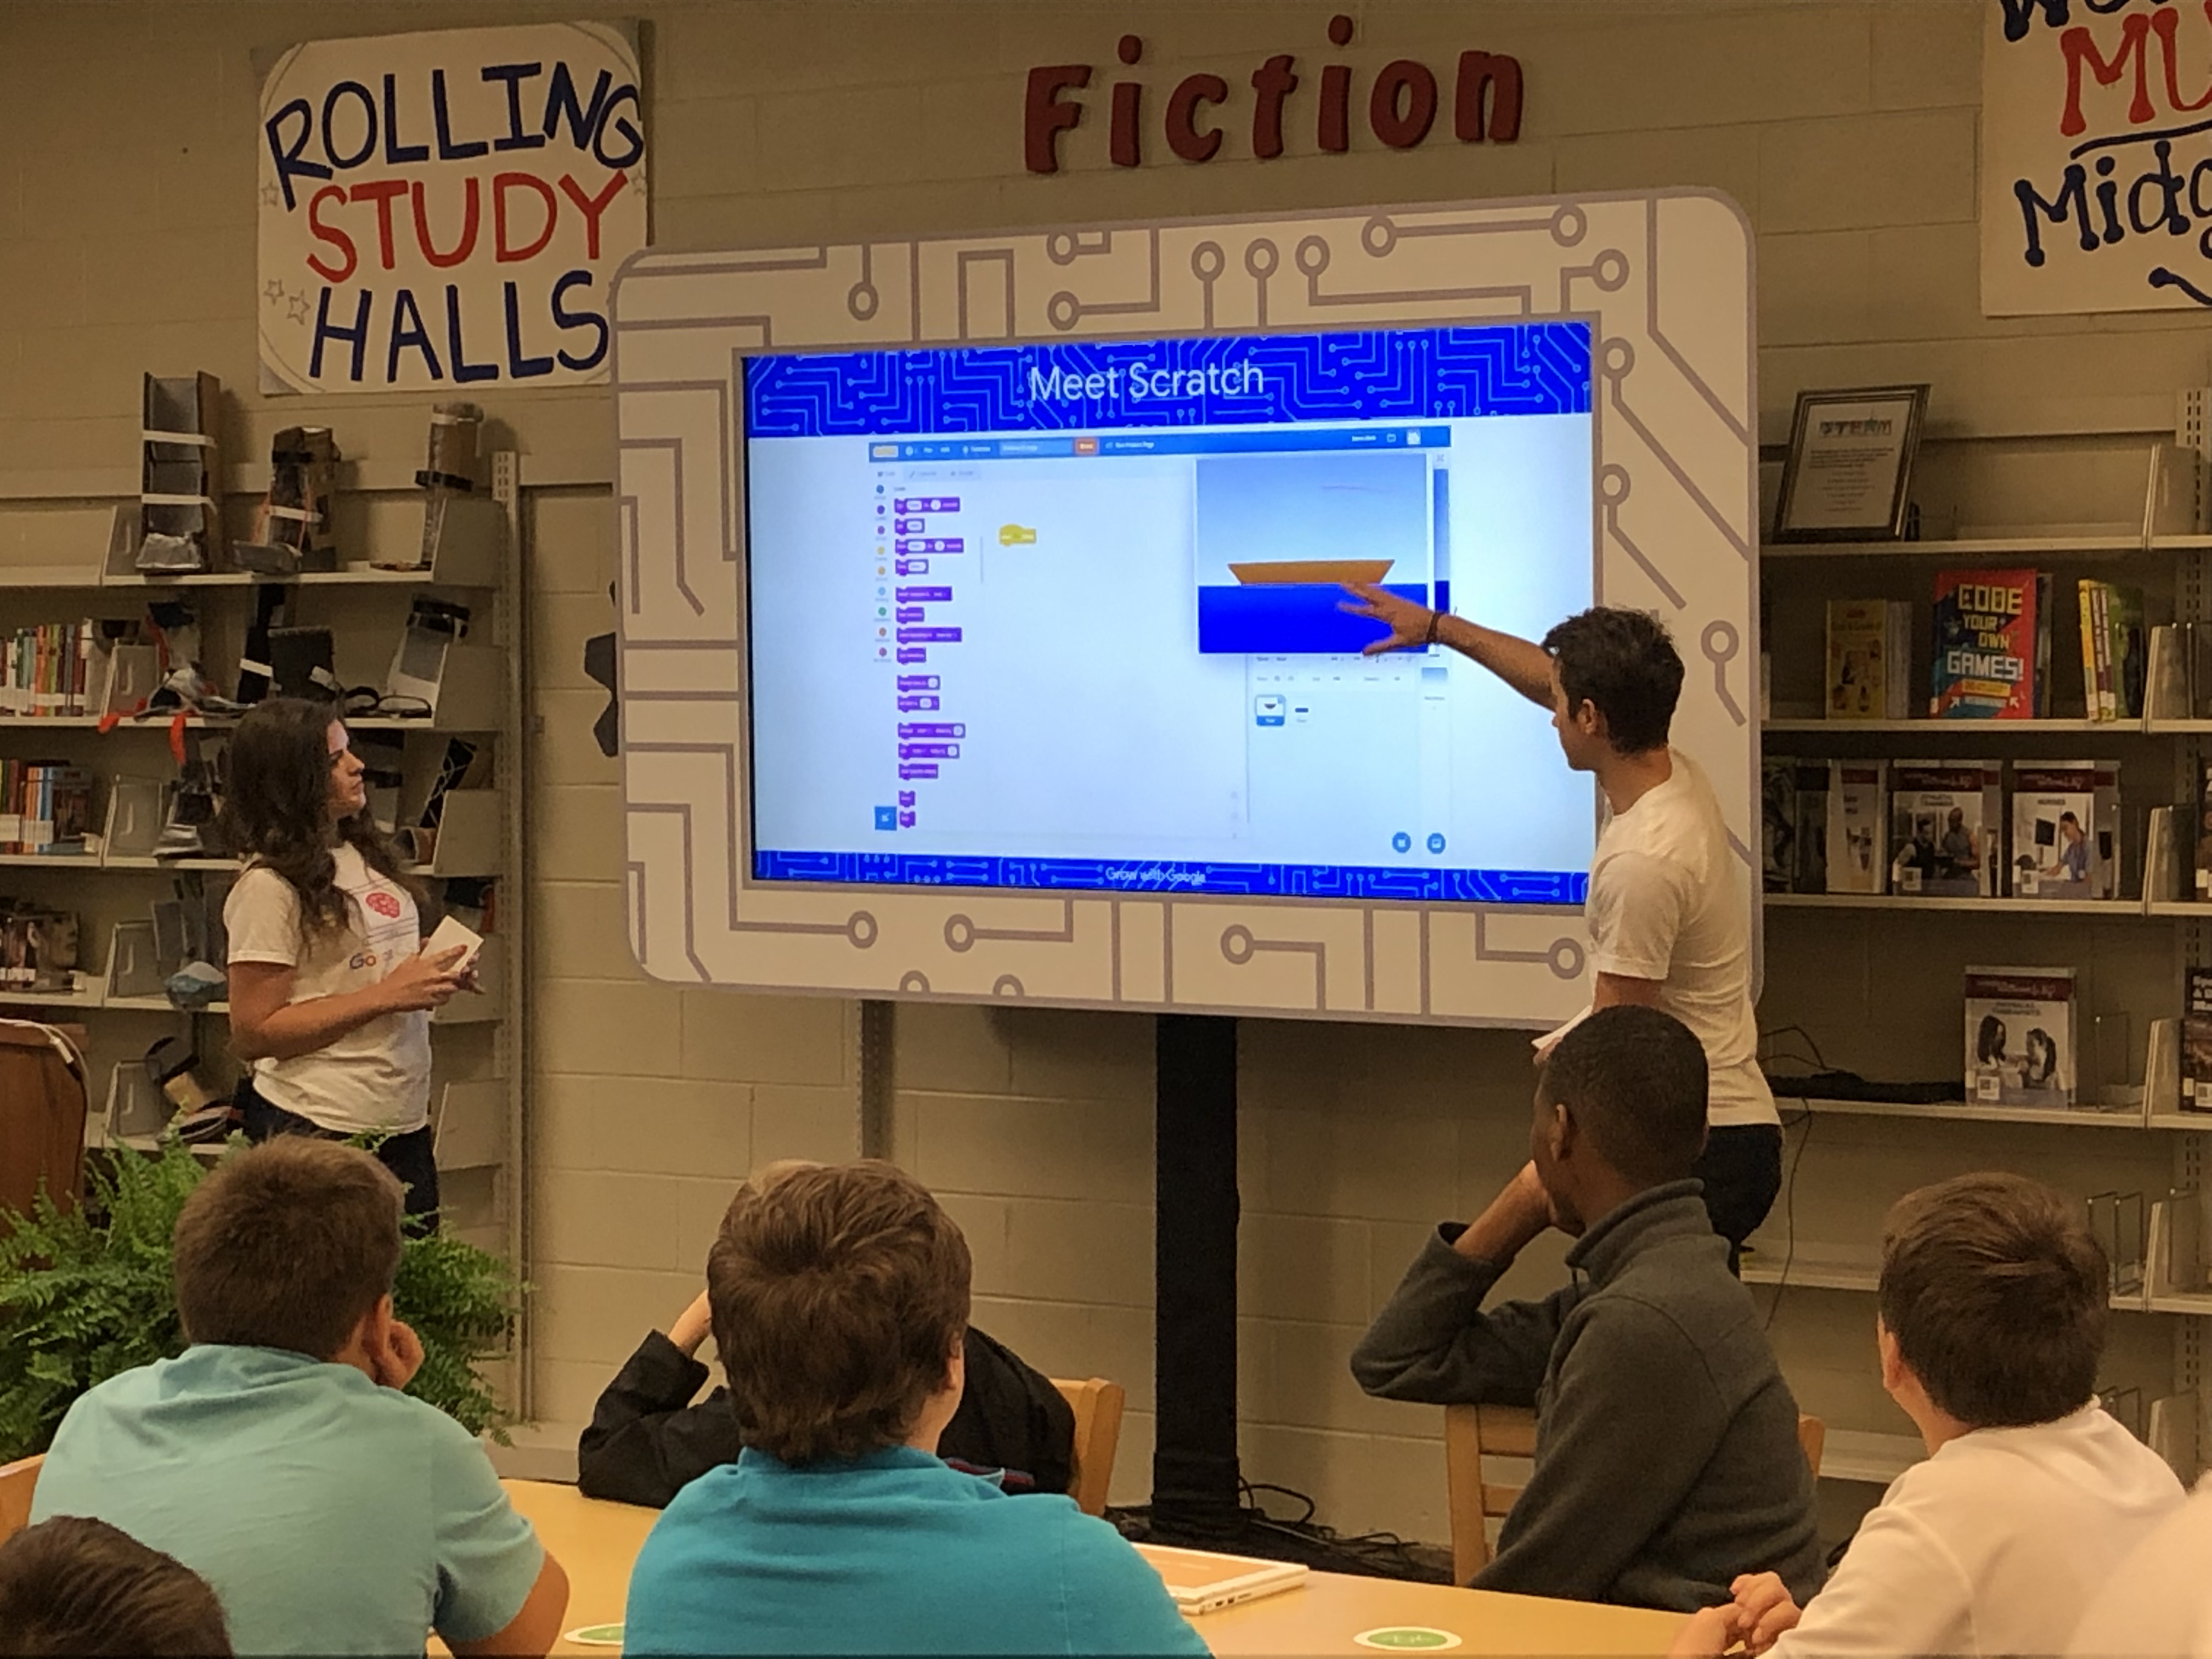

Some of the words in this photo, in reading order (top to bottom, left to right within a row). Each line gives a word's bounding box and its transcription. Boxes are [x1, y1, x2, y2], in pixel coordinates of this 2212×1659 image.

[1024, 14, 1523, 173] Fiction
[265, 61, 644, 212] ROLLING
[307, 170, 628, 284] STUDY
[309, 270, 609, 383] HALLS
[1030, 365, 1119, 401] Meet
[1129, 358, 1263, 398] Scratch
[1958, 584, 2023, 615] CODE
[1962, 613, 1998, 631] YOUR
[1978, 632, 2010, 649] OWN
[1948, 651, 2024, 681] GAMES!
[1105, 866, 1137, 881] Grow
[1166, 868, 1206, 886] Google
